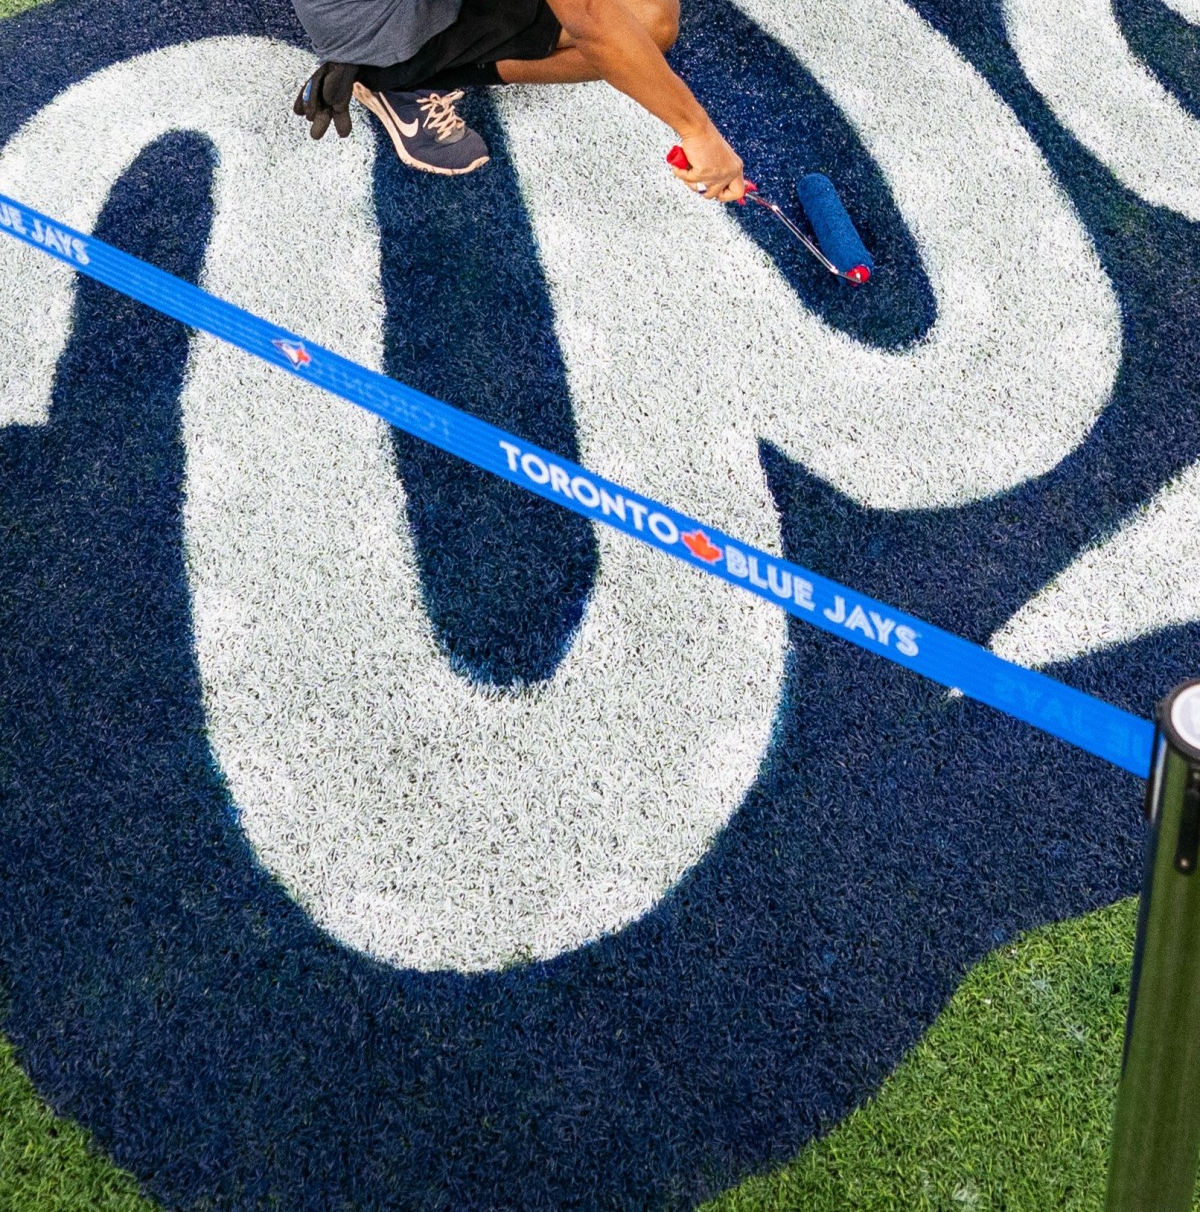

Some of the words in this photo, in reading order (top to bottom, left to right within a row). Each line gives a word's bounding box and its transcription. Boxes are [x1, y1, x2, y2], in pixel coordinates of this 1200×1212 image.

[31, 218, 90, 265] JAYS
[500, 440, 680, 545] TORONTO
[725, 546, 817, 613] BLUE
[823, 594, 920, 658] JAYS
